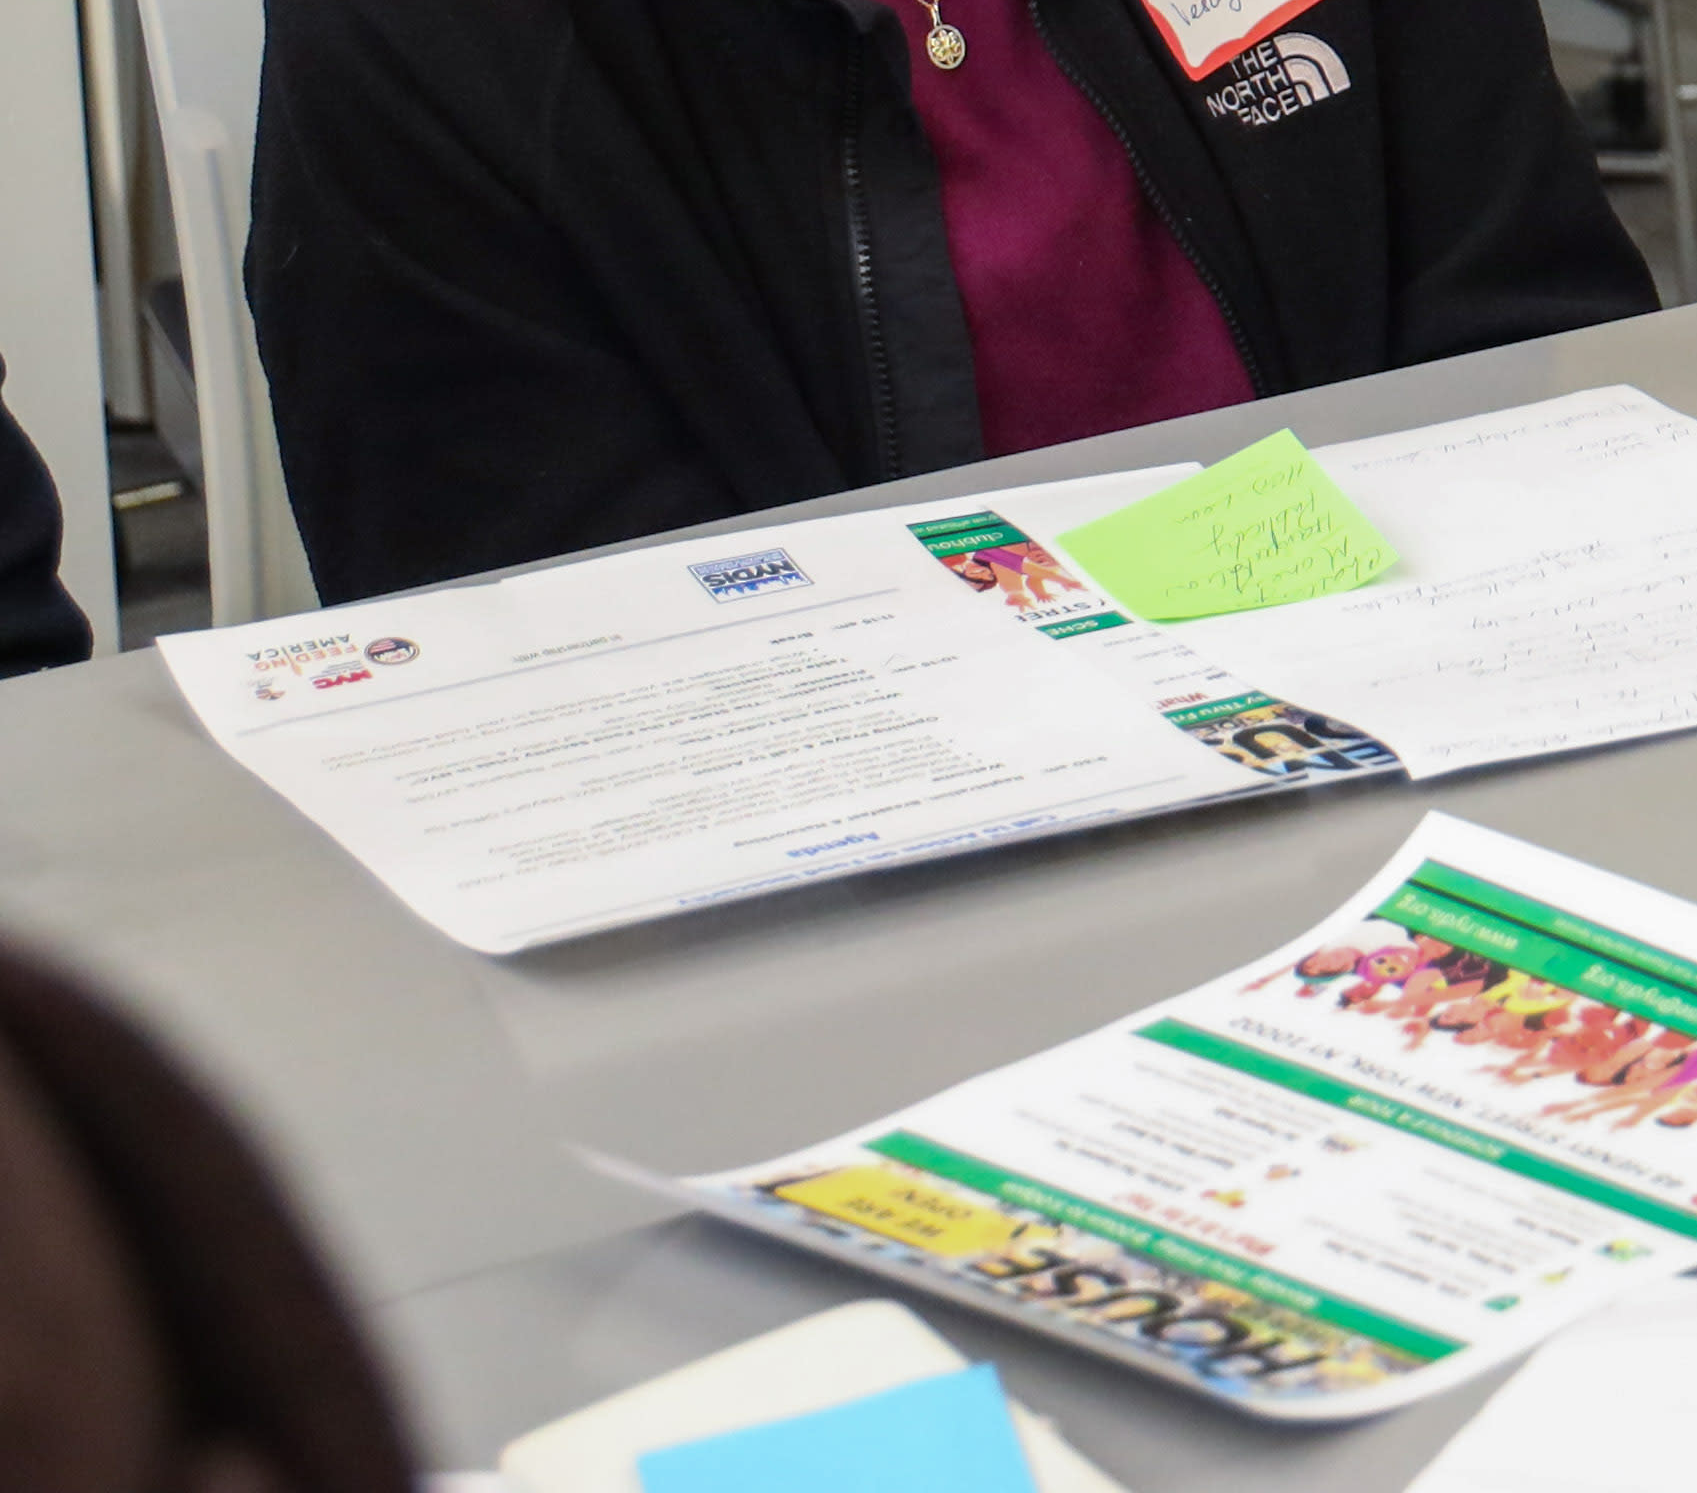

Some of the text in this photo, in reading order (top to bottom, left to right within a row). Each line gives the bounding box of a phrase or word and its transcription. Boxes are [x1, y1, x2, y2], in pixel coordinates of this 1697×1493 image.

[1228, 40, 1279, 78] THE
[1205, 64, 1290, 118] NORTH
[1237, 88, 1301, 126] FACE
[702, 560, 796, 587] NYDIS
[246, 633, 350, 663] AMERICA
[254, 645, 358, 673] FEEDING
[312, 668, 373, 691] NYC
[785, 831, 881, 859] Agenda
